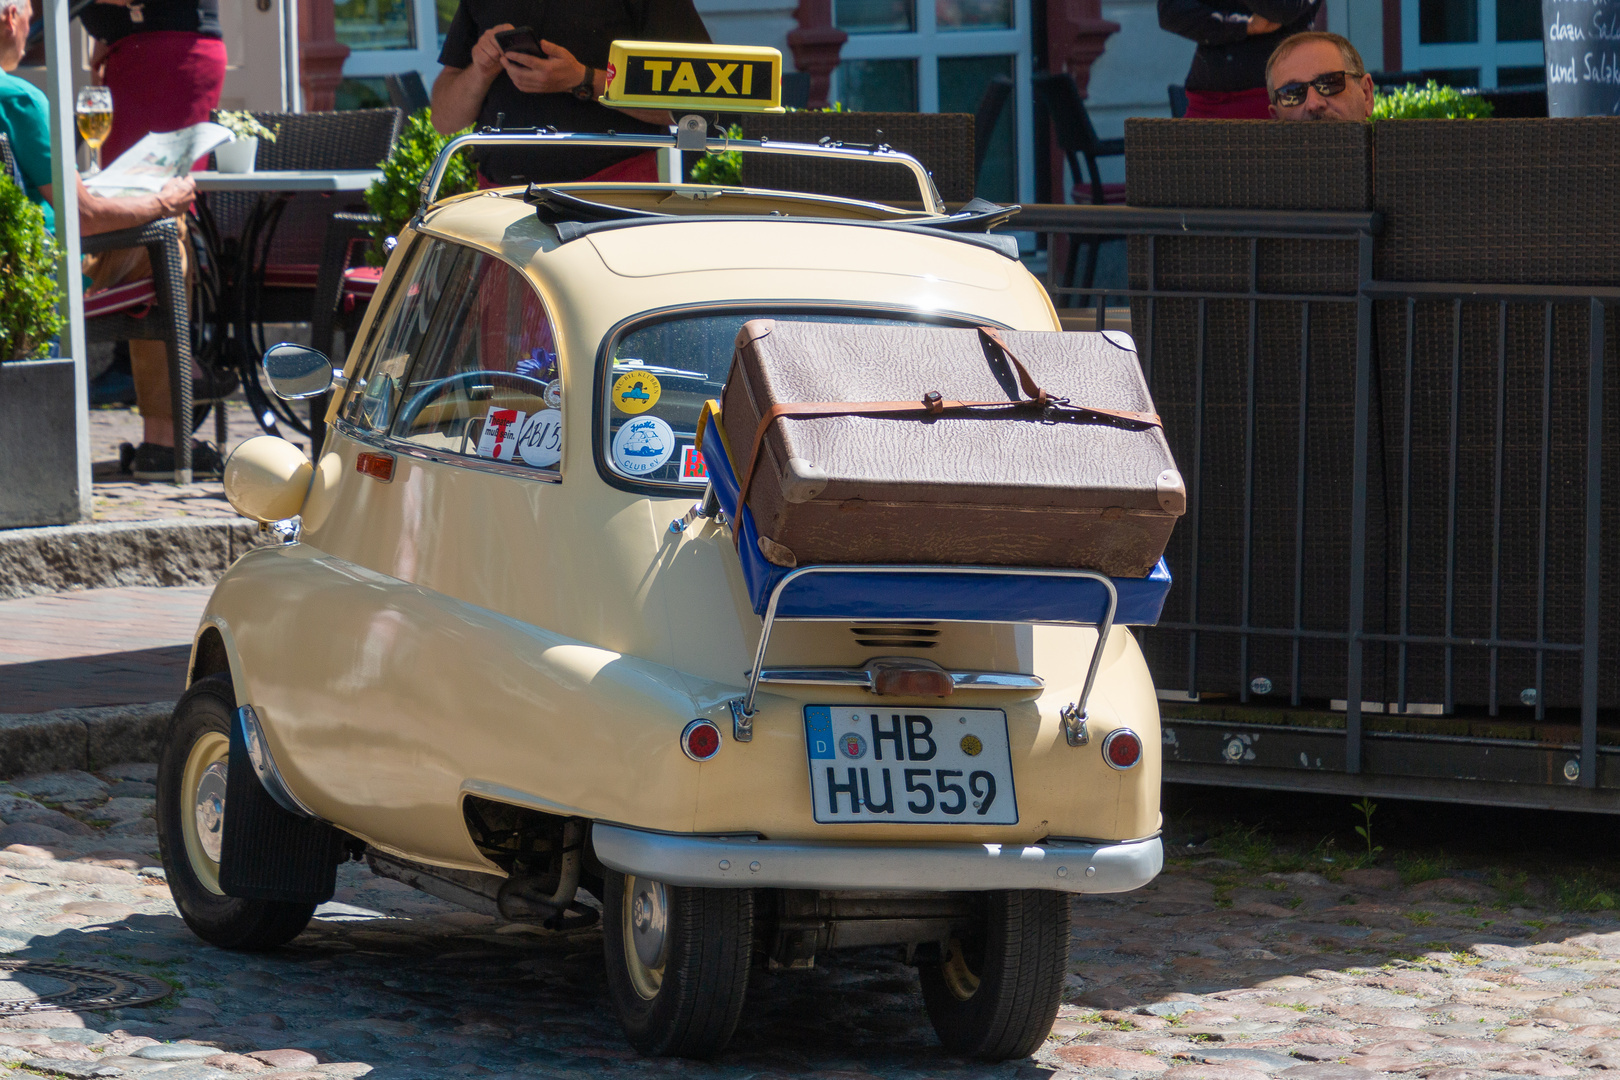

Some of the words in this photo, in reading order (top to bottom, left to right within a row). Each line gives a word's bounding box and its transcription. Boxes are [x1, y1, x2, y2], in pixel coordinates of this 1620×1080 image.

[1550, 11, 1585, 41] dazu
[644, 60, 753, 95] TAXI
[1550, 55, 1578, 84] und
[484, 427, 500, 437] muß
[500, 430, 515, 440] sein.
[488, 414, 513, 428] Theater
[519, 419, 551, 447] ABI
[624, 459, 647, 470] CLUB
[816, 740, 827, 753] D
[870, 714, 937, 762] HB
[826, 767, 895, 814] HU
[903, 768, 997, 815] 559
